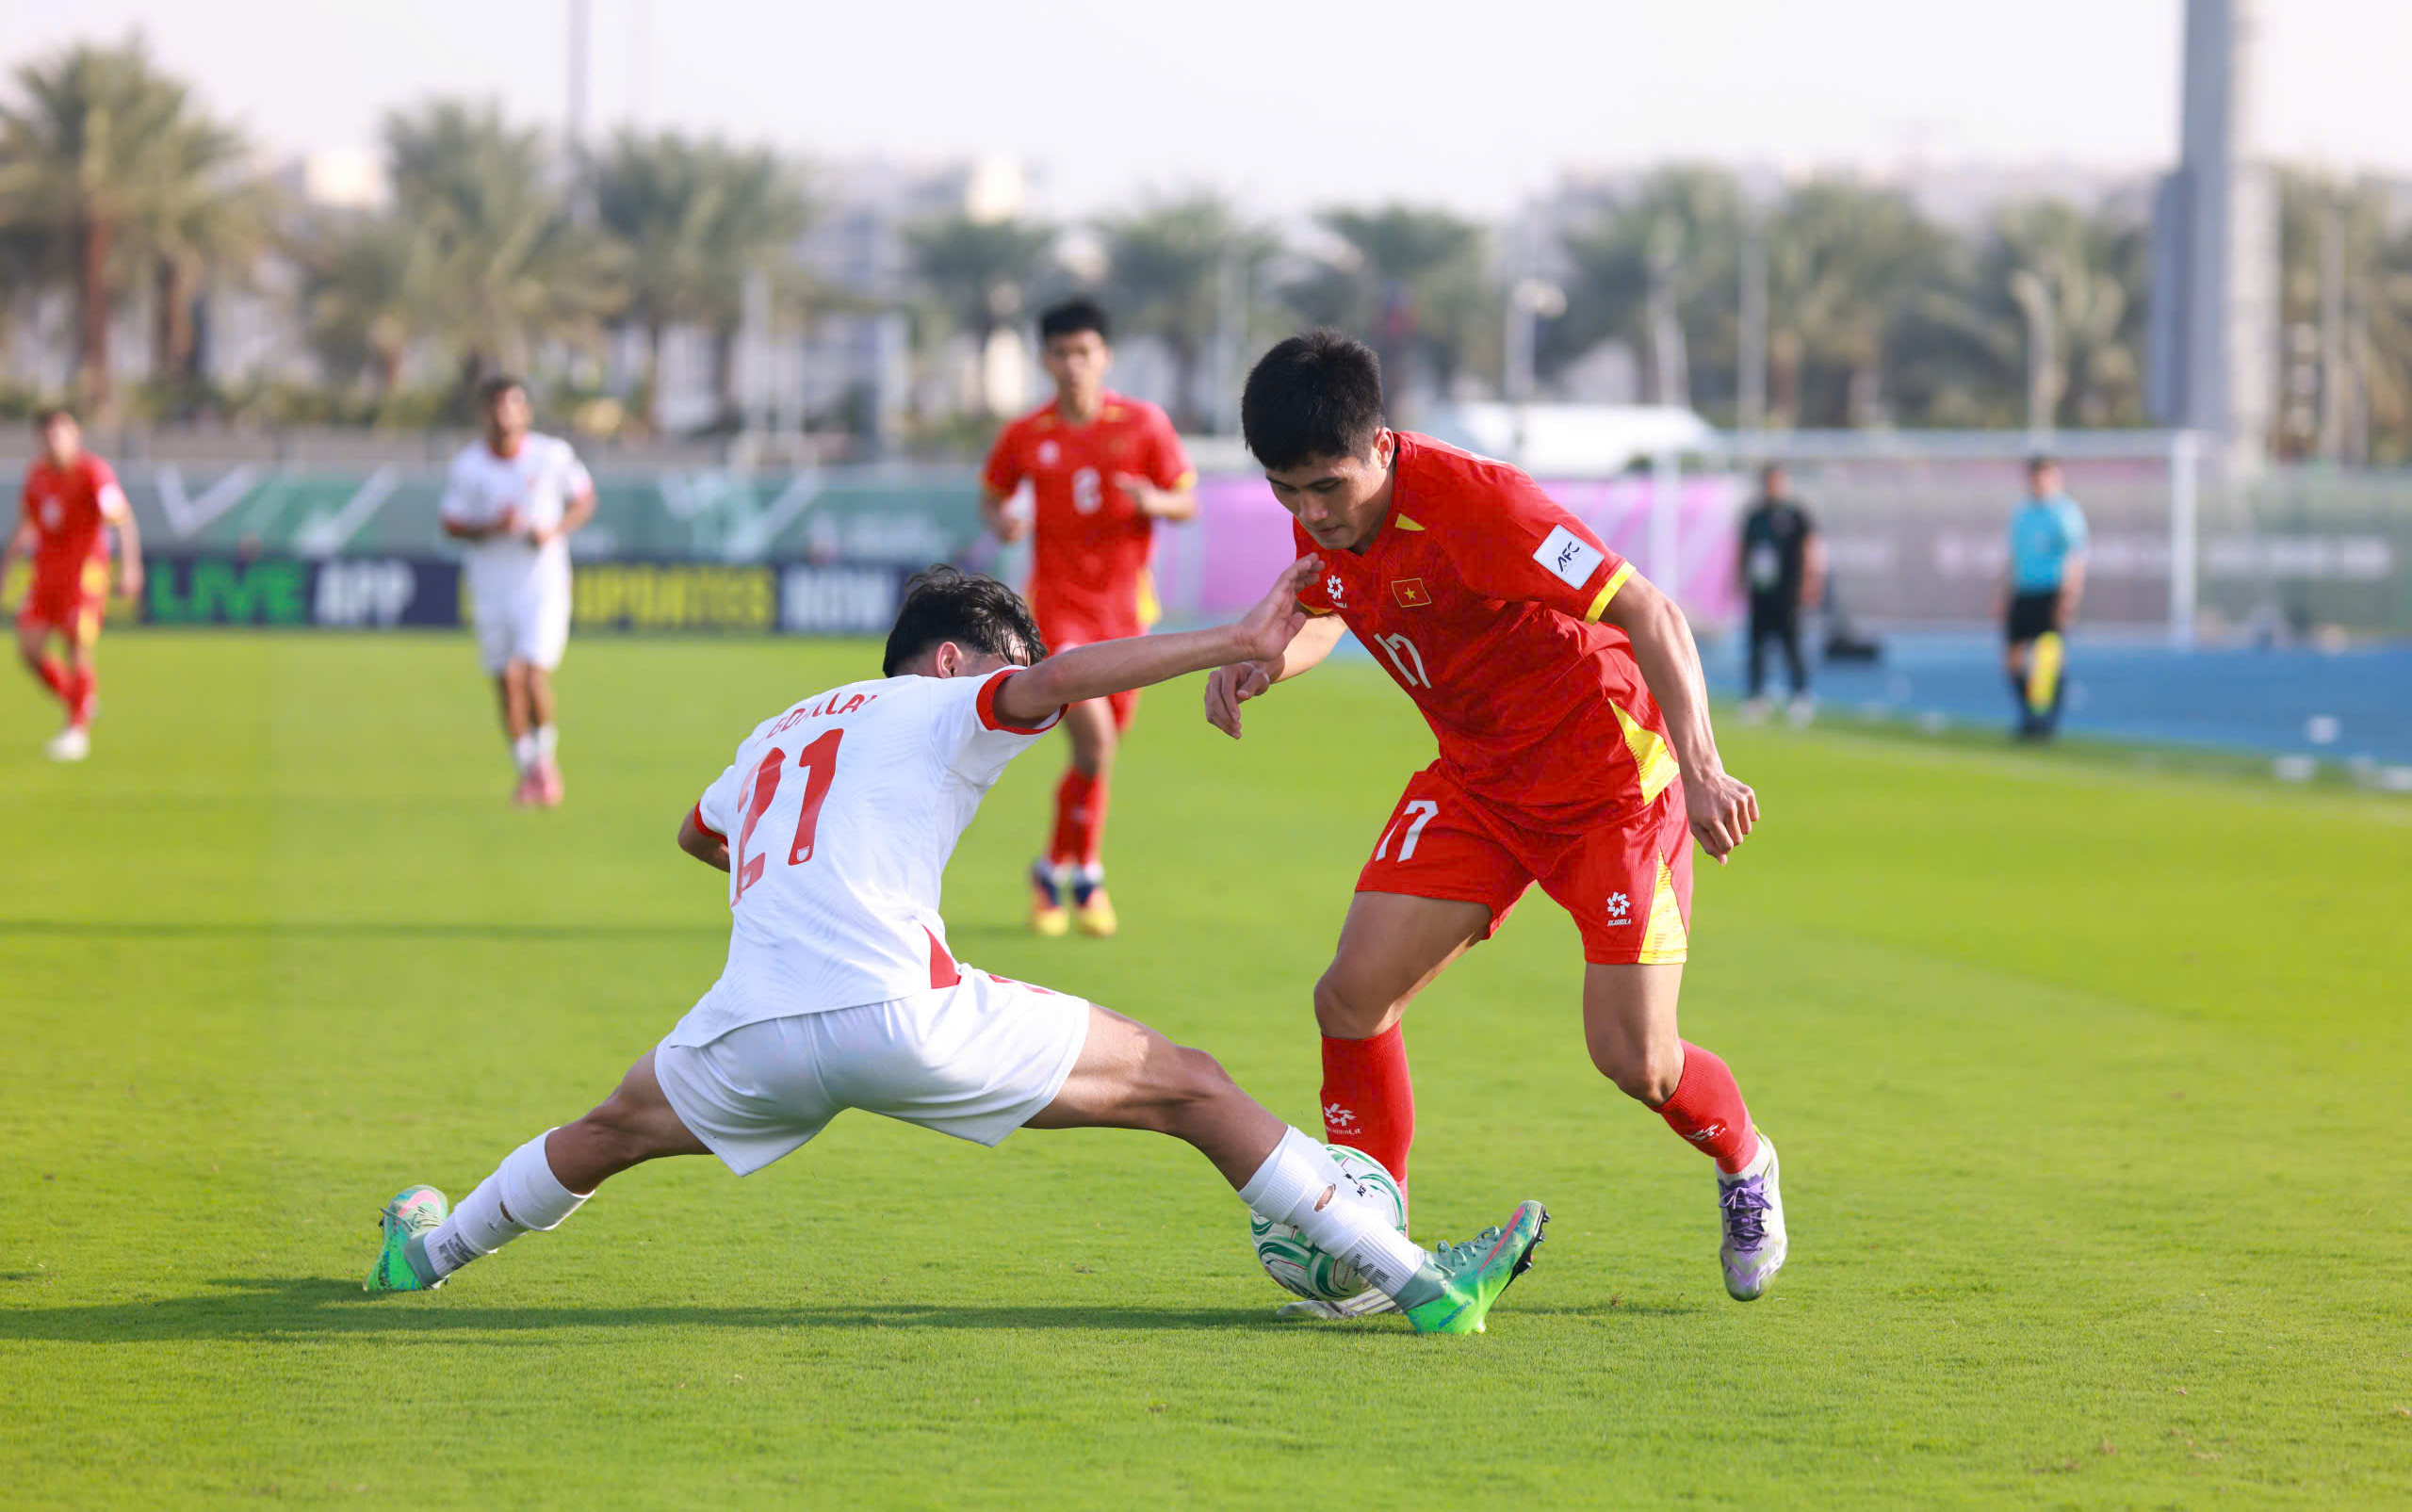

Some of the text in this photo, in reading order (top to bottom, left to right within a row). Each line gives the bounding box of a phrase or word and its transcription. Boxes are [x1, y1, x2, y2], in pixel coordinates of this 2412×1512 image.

[1557, 541, 1580, 573] AFC
[150, 559, 417, 629] LIVE APP
[1374, 632, 1432, 689] 17
[730, 728, 844, 908] 21
[1375, 800, 1439, 862] 17
